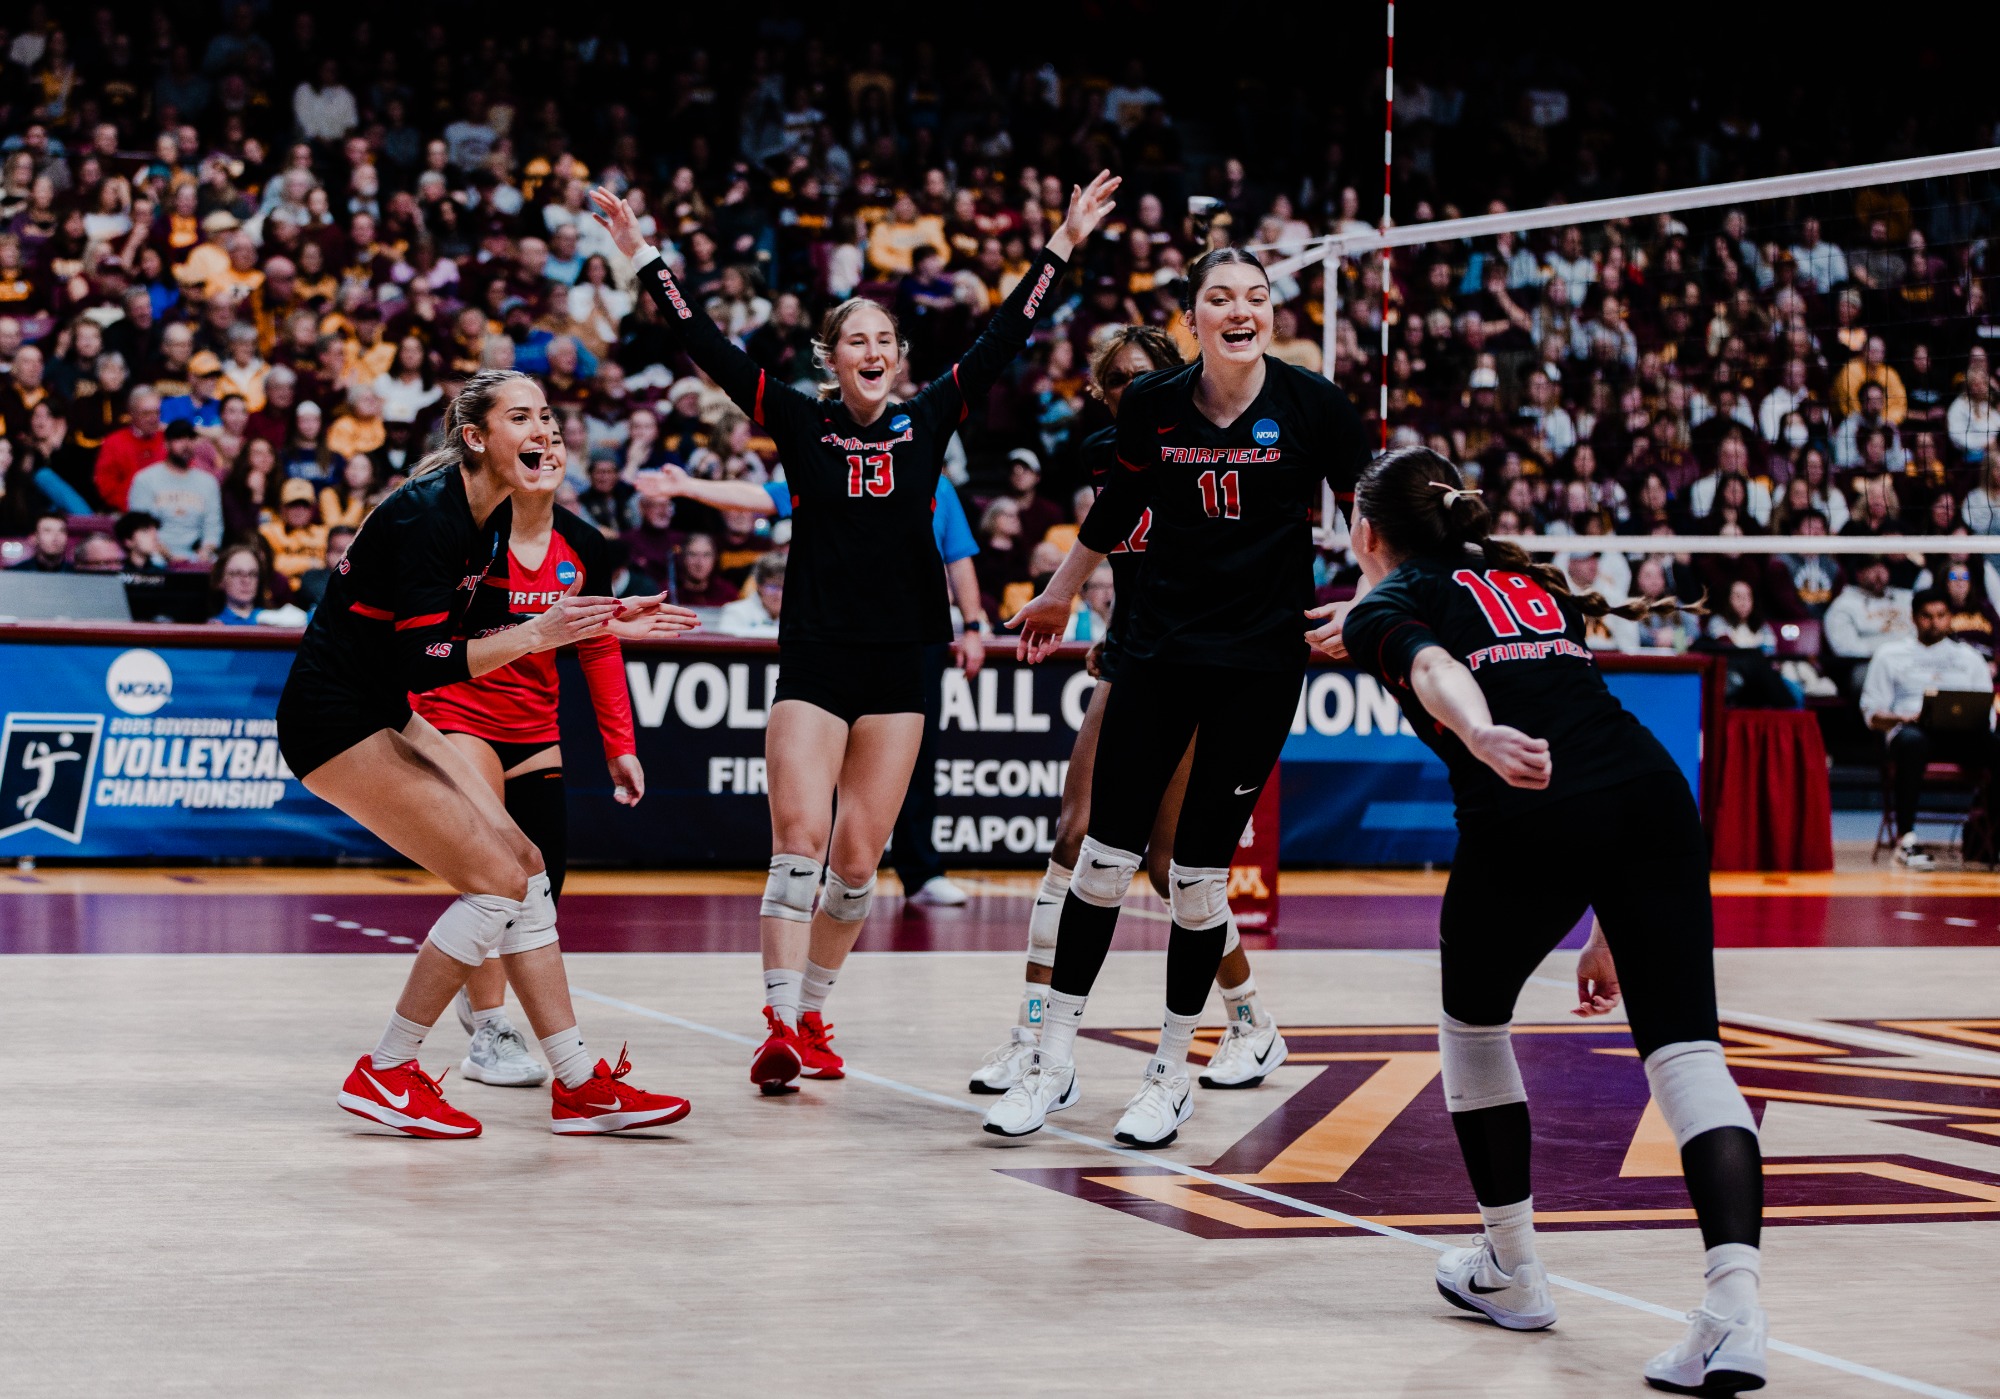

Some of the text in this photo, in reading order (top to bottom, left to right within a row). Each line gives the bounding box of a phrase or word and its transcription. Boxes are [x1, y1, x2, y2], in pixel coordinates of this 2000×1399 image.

[657, 269, 693, 320] STAGS
[1023, 263, 1056, 320] STAGS
[1160, 446, 1282, 464] FAIRFIELD
[1256, 431, 1279, 440] NCAA
[846, 451, 895, 497] 13
[1197, 470, 1241, 520] 11
[1452, 569, 1567, 638] 18
[116, 681, 169, 697] NCAA
[153, 717, 233, 737] DIVISION
[95, 778, 286, 810] CHAMPIONSHIP
